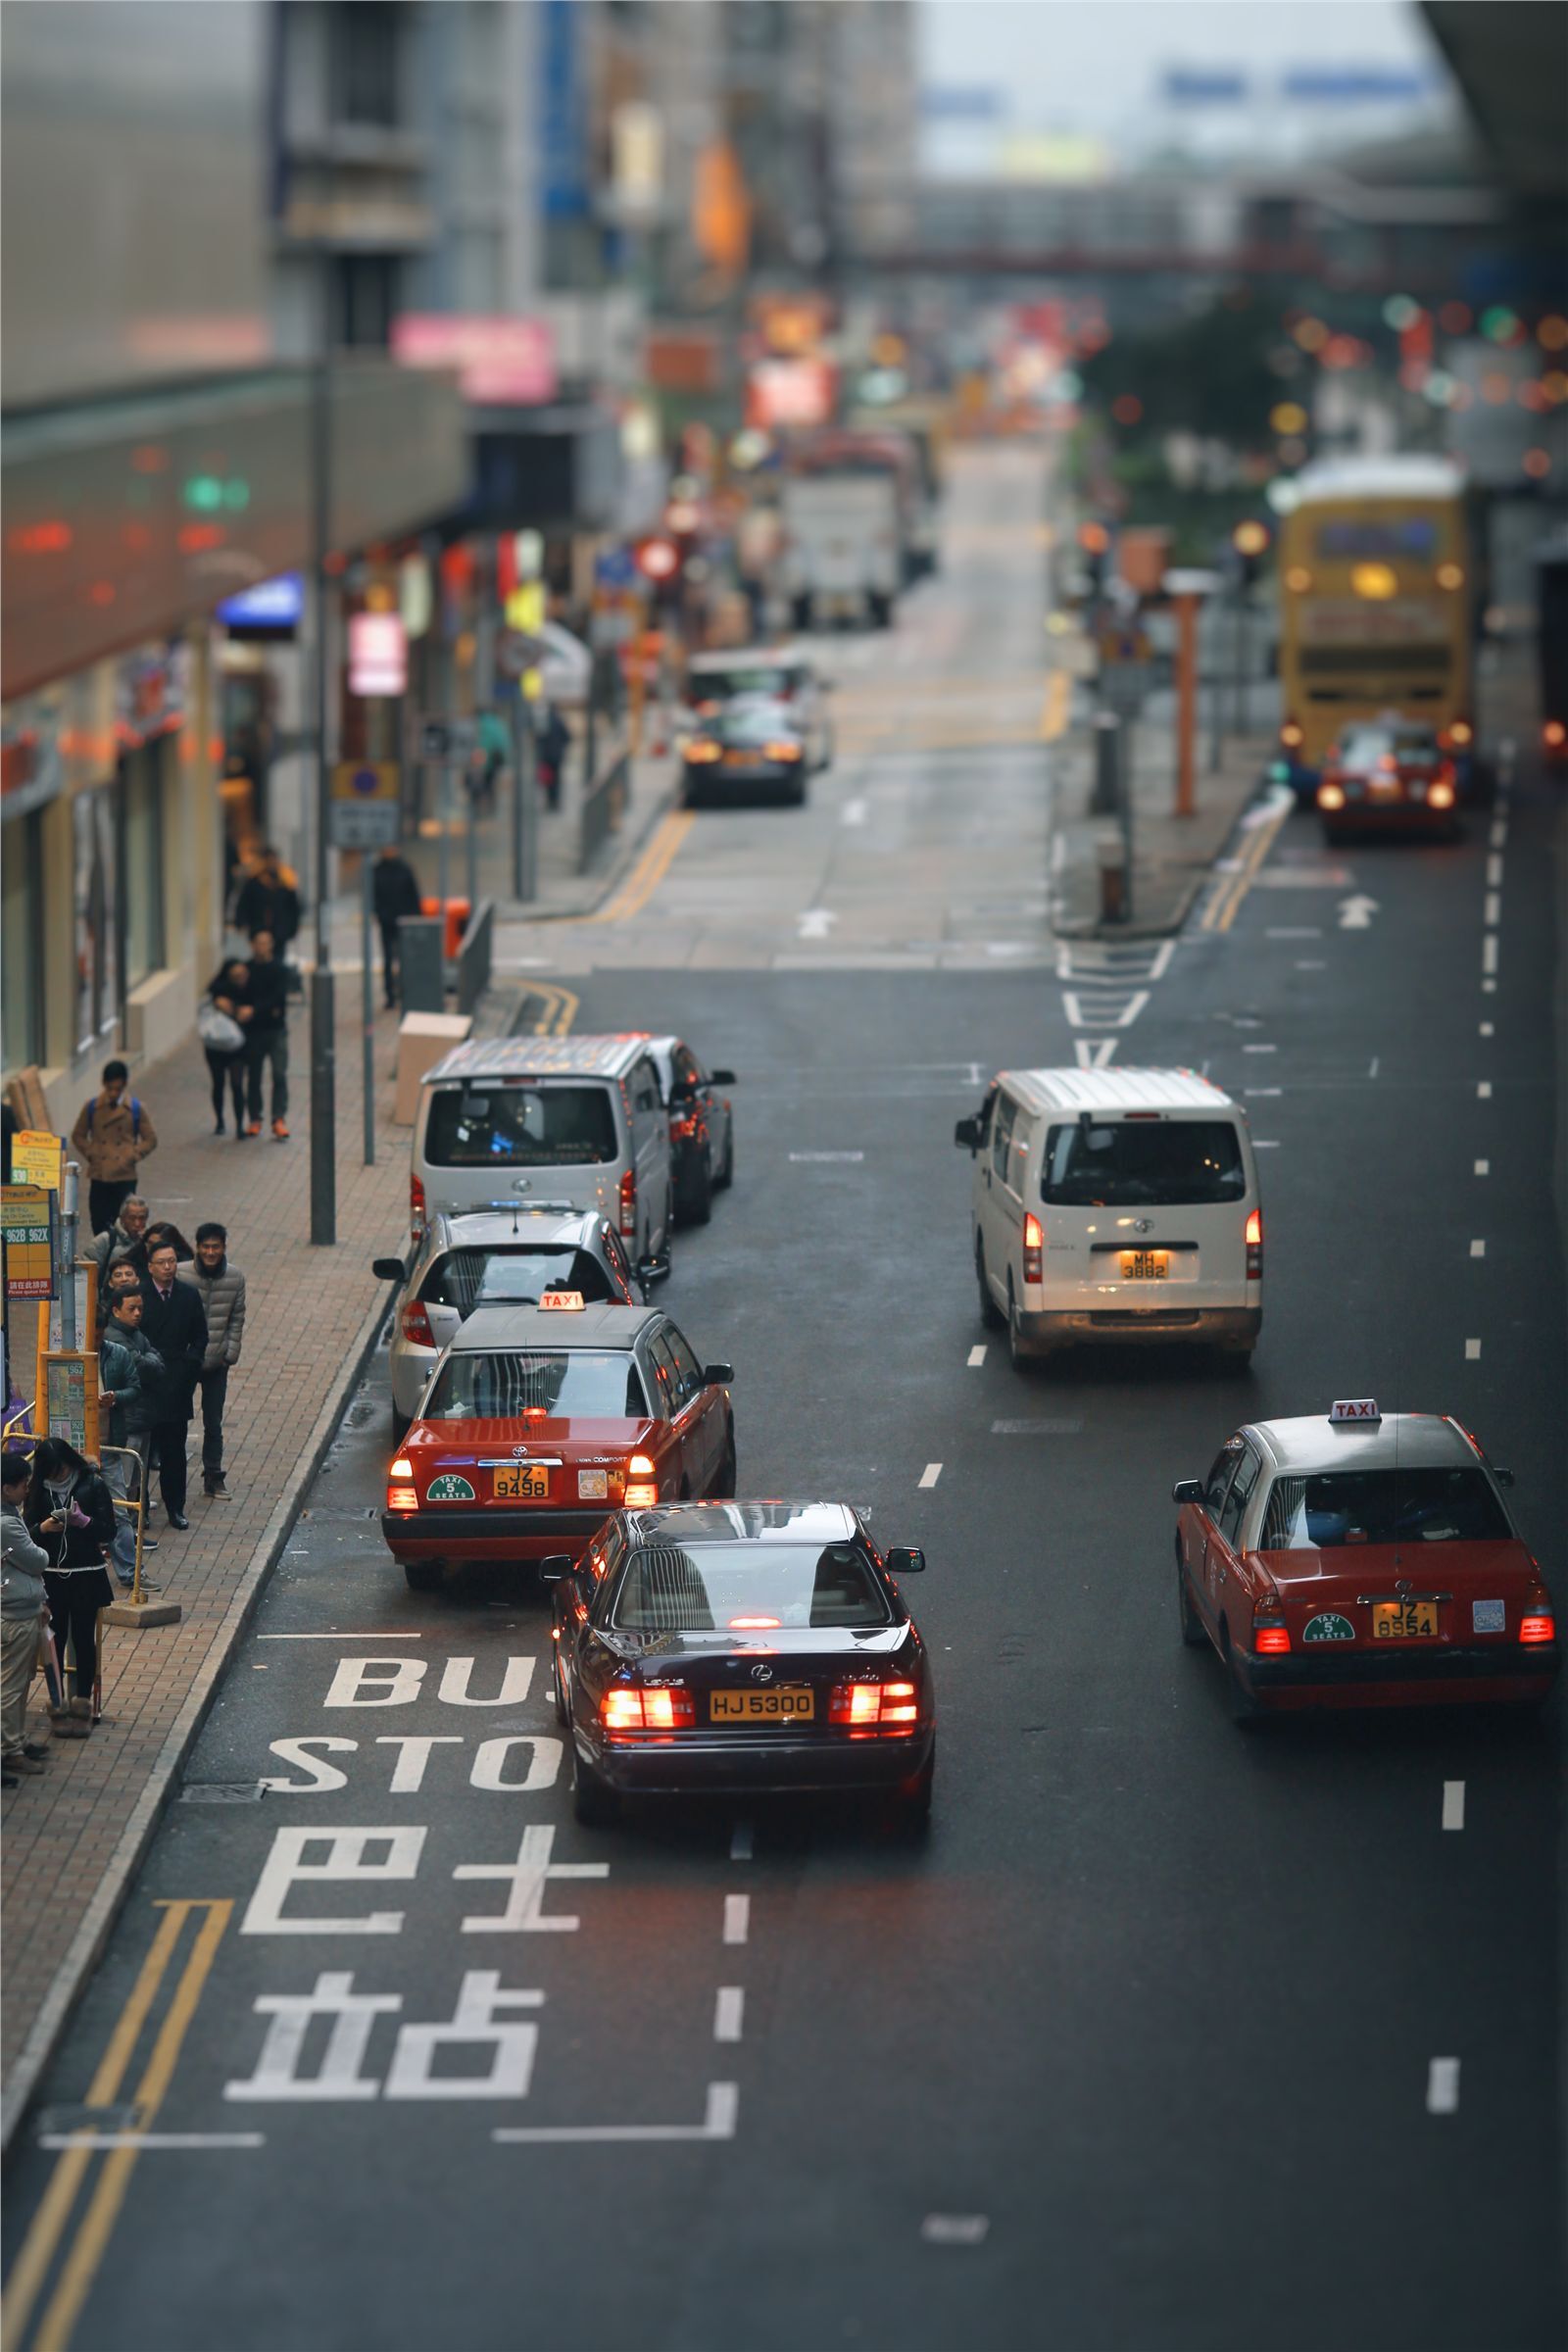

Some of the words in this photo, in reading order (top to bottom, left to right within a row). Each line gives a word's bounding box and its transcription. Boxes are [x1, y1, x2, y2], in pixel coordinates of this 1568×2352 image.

[7, 1229, 26, 1243] 962B
[28, 1228, 48, 1242] 962X
[1134, 1254, 1154, 1266] MH
[1124, 1265, 1165, 1279] 3882
[10, 1280, 48, 1290] 請在此排隊
[543, 1295, 578, 1307] TAXI
[69, 1365, 84, 1374] 962
[1336, 1403, 1376, 1418] TAXI
[440, 1475, 462, 1486] TAXI
[510, 1466, 533, 1483] JZ
[446, 1483, 455, 1494] 5
[497, 1481, 545, 1496] 9498
[1392, 1602, 1418, 1621] JZ
[1317, 1615, 1340, 1624] TAXI
[1324, 1622, 1334, 1634] 5
[1378, 1619, 1432, 1637] 8954
[1312, 1632, 1347, 1641] SEATS
[713, 1696, 744, 1715] HJ
[749, 1694, 810, 1713] 5300
[259, 1737, 575, 1792] STO
[240, 1826, 610, 1935] 巴士
[223, 1970, 545, 2101] 站
